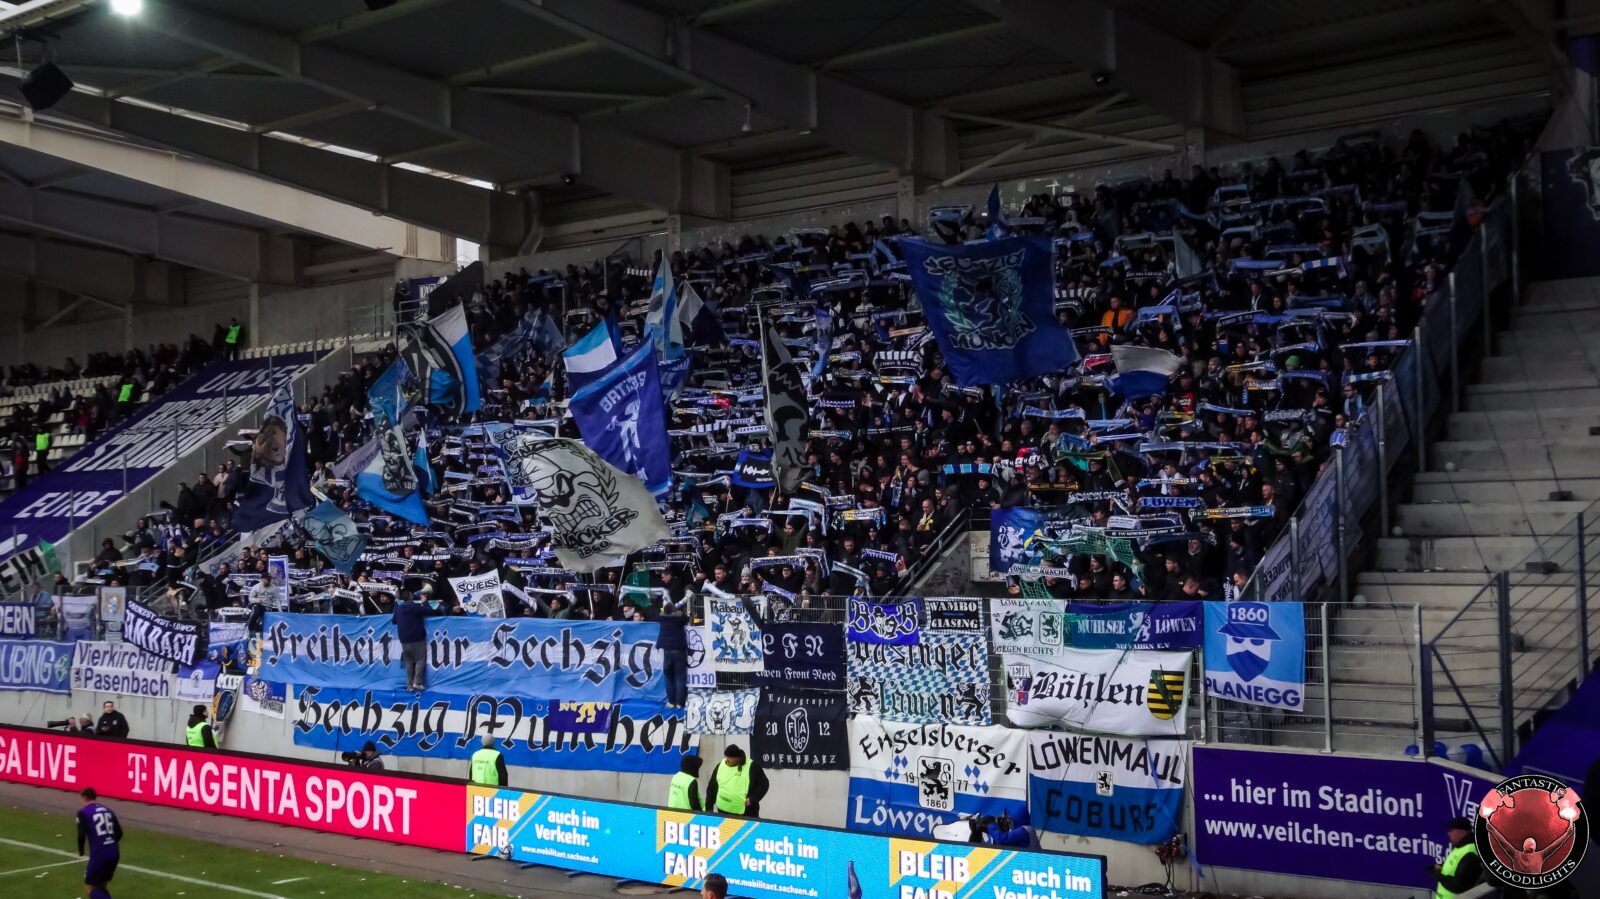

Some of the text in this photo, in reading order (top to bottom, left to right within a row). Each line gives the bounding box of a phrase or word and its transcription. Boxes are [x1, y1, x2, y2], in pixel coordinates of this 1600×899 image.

[196, 364, 318, 394] UNSER
[13, 490, 124, 518] EURE
[457, 576, 499, 595] SCHEISS
[929, 601, 977, 612] WAMBO
[1230, 607, 1268, 622] 1860
[1155, 615, 1196, 634] LÖWEN
[268, 621, 393, 666] Freiheit
[430, 630, 471, 670] ür
[487, 622, 661, 688] Sechzig
[996, 645, 1054, 656] GEGEN RECHTS
[84, 667, 169, 697] Pasenbach
[784, 667, 810, 680] Front
[813, 669, 836, 681] Nord
[1032, 672, 1145, 709] Böhlen
[1203, 677, 1301, 707] PLANEGG
[292, 686, 450, 751] Sechzig
[818, 721, 830, 736] 12
[27, 740, 77, 784] LIVE
[1029, 733, 1182, 785] LÖWENMAUL
[153, 756, 300, 819] MAGENTA
[304, 774, 418, 835] SPORT
[904, 772, 969, 792] 19 77
[473, 794, 520, 823] BLEIB
[925, 798, 948, 810] 1860
[1230, 778, 1277, 805] hier
[1282, 782, 1312, 808] im
[1317, 785, 1424, 818] Stadion!
[93, 812, 114, 836] 26
[547, 808, 600, 830] auch im
[534, 823, 590, 848] Verkehr.
[664, 820, 722, 850] BLEIB
[754, 835, 819, 860] auch im
[1204, 818, 1452, 866] www.veilchen-catering.d
[738, 852, 807, 879] Verkehr.
[900, 849, 971, 883] BLEIB
[1012, 866, 1060, 890] auch
[1065, 868, 1093, 893] im
